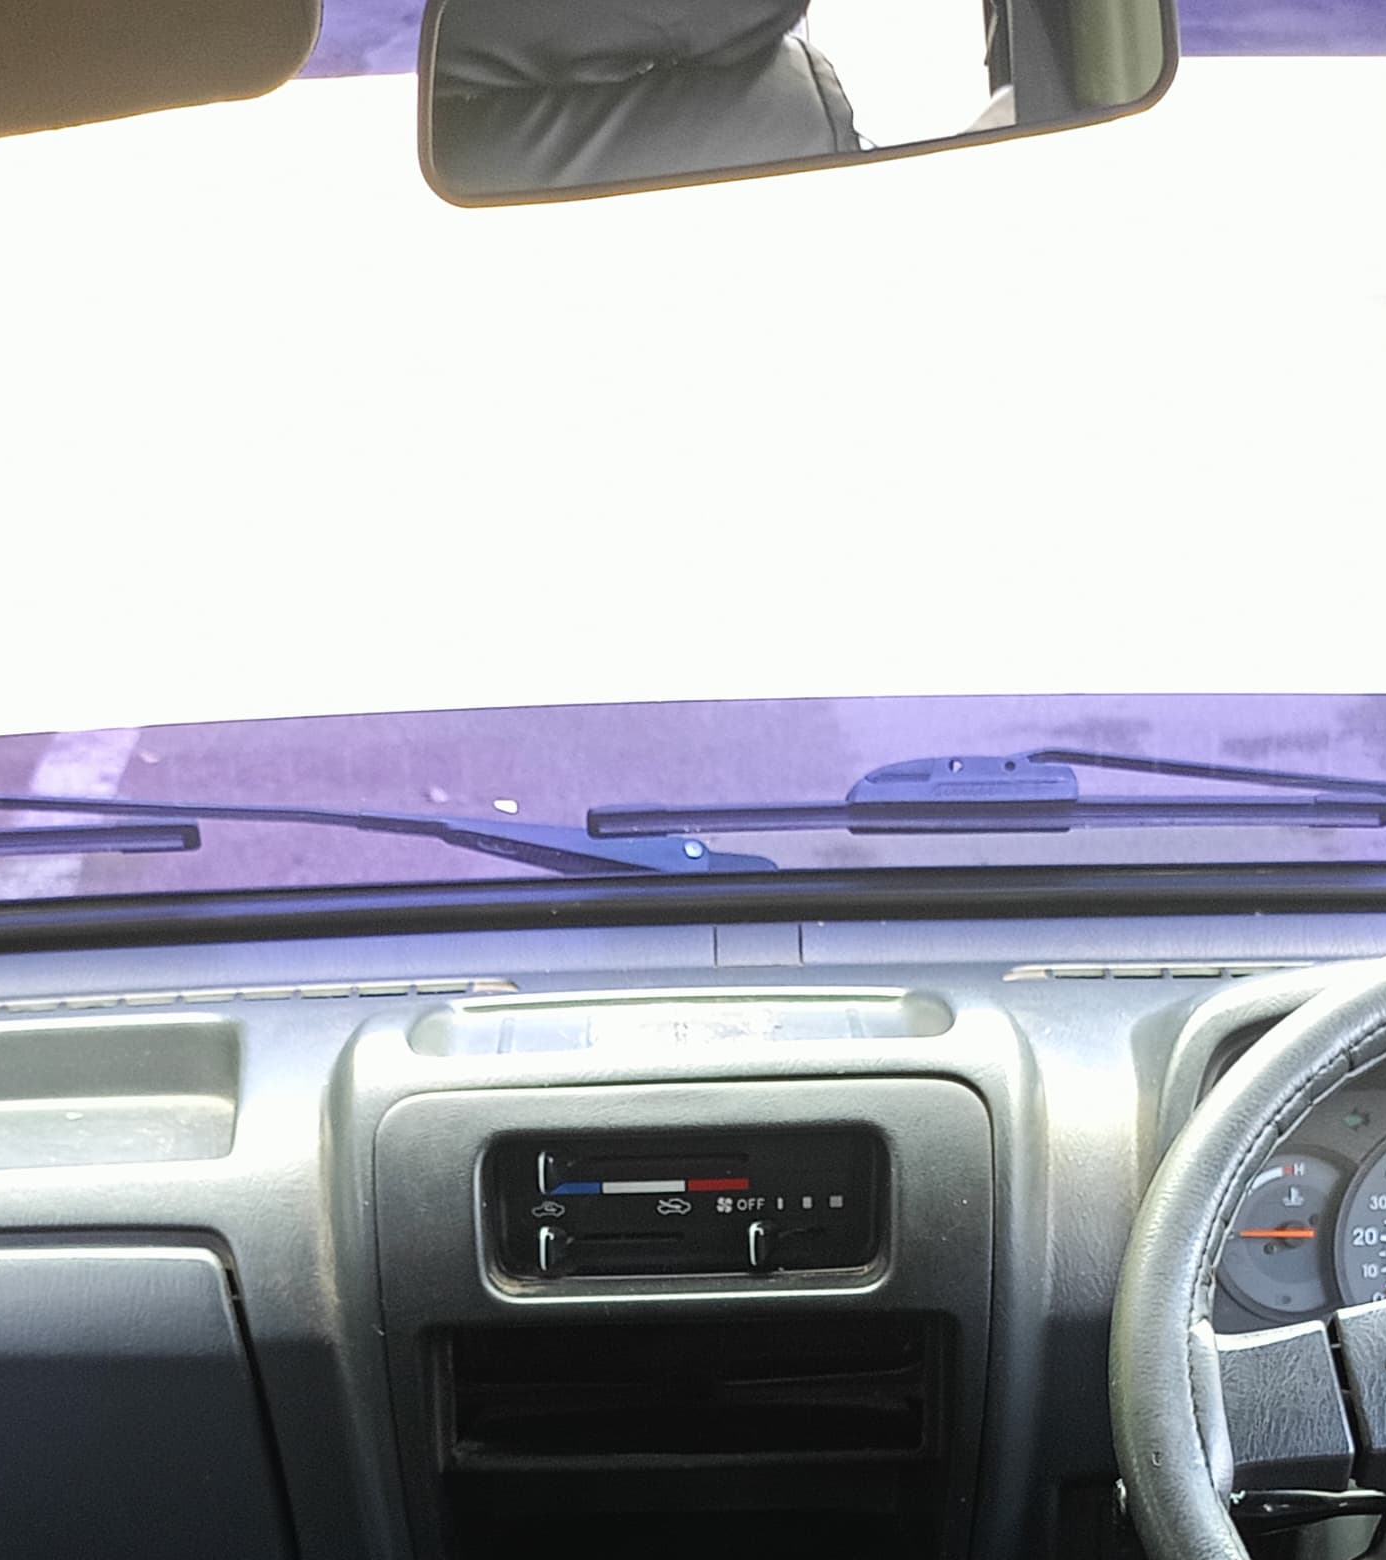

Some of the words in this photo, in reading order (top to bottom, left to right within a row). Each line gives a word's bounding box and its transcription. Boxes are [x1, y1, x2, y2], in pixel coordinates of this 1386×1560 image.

[1293, 1162, 1305, 1176] H
[736, 1198, 766, 1211] OFF
[1352, 1227, 1378, 1246] 20
[1362, 1264, 1378, 1278] 10
